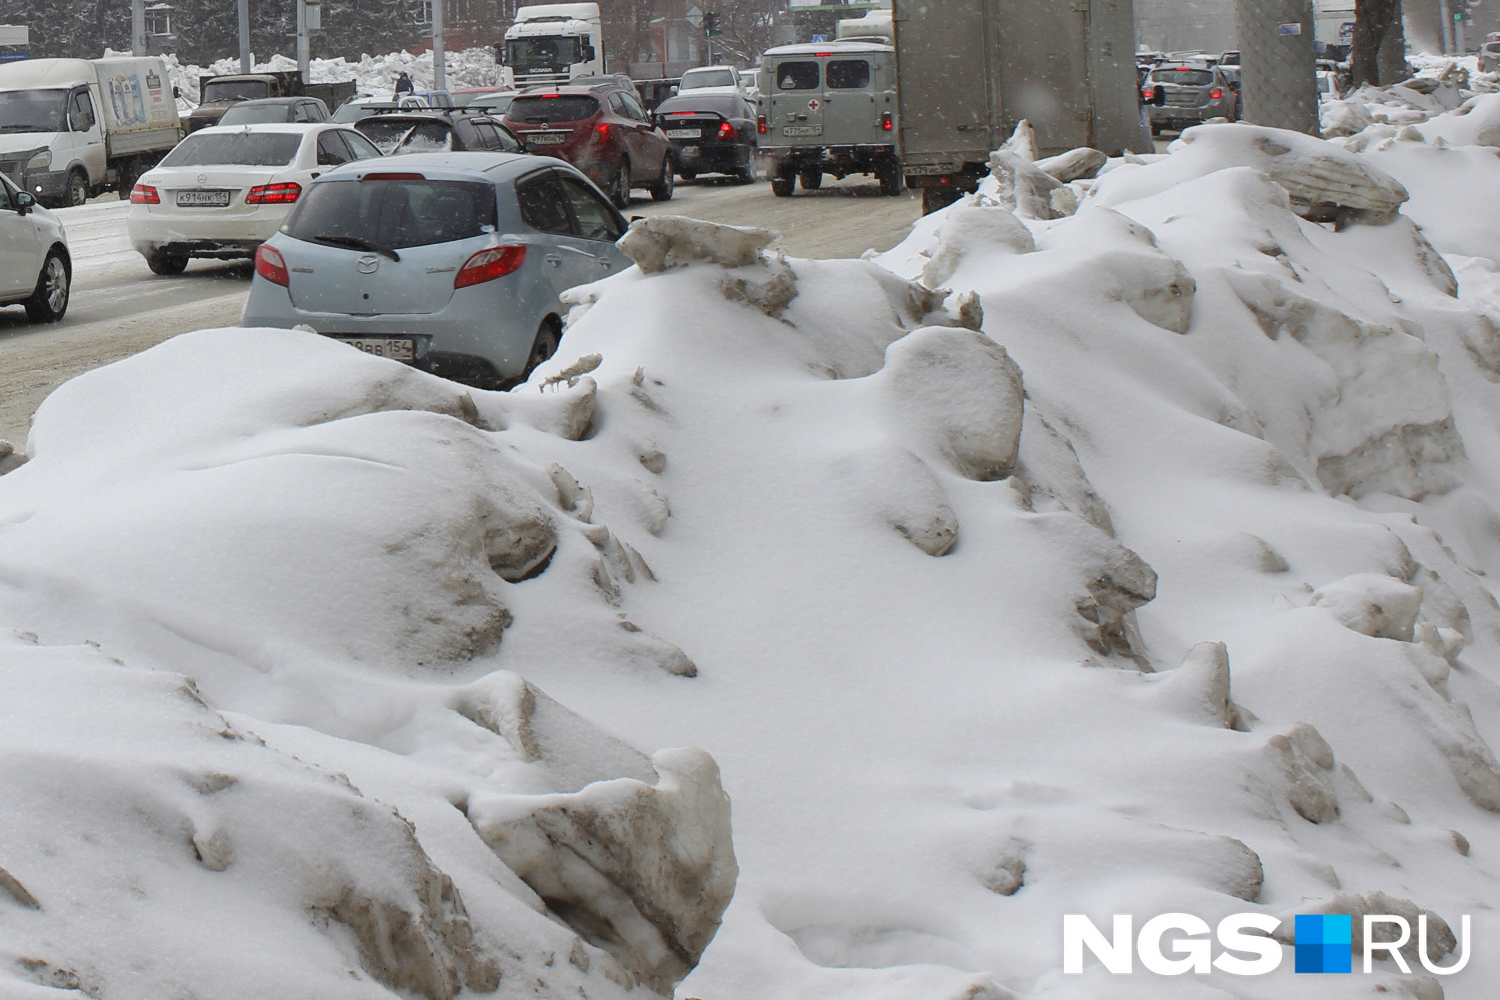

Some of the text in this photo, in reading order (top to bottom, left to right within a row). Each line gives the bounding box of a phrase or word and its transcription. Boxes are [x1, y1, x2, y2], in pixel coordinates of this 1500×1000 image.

[180, 192, 227, 202] К914НК 154
[387, 341, 411, 352] 154
